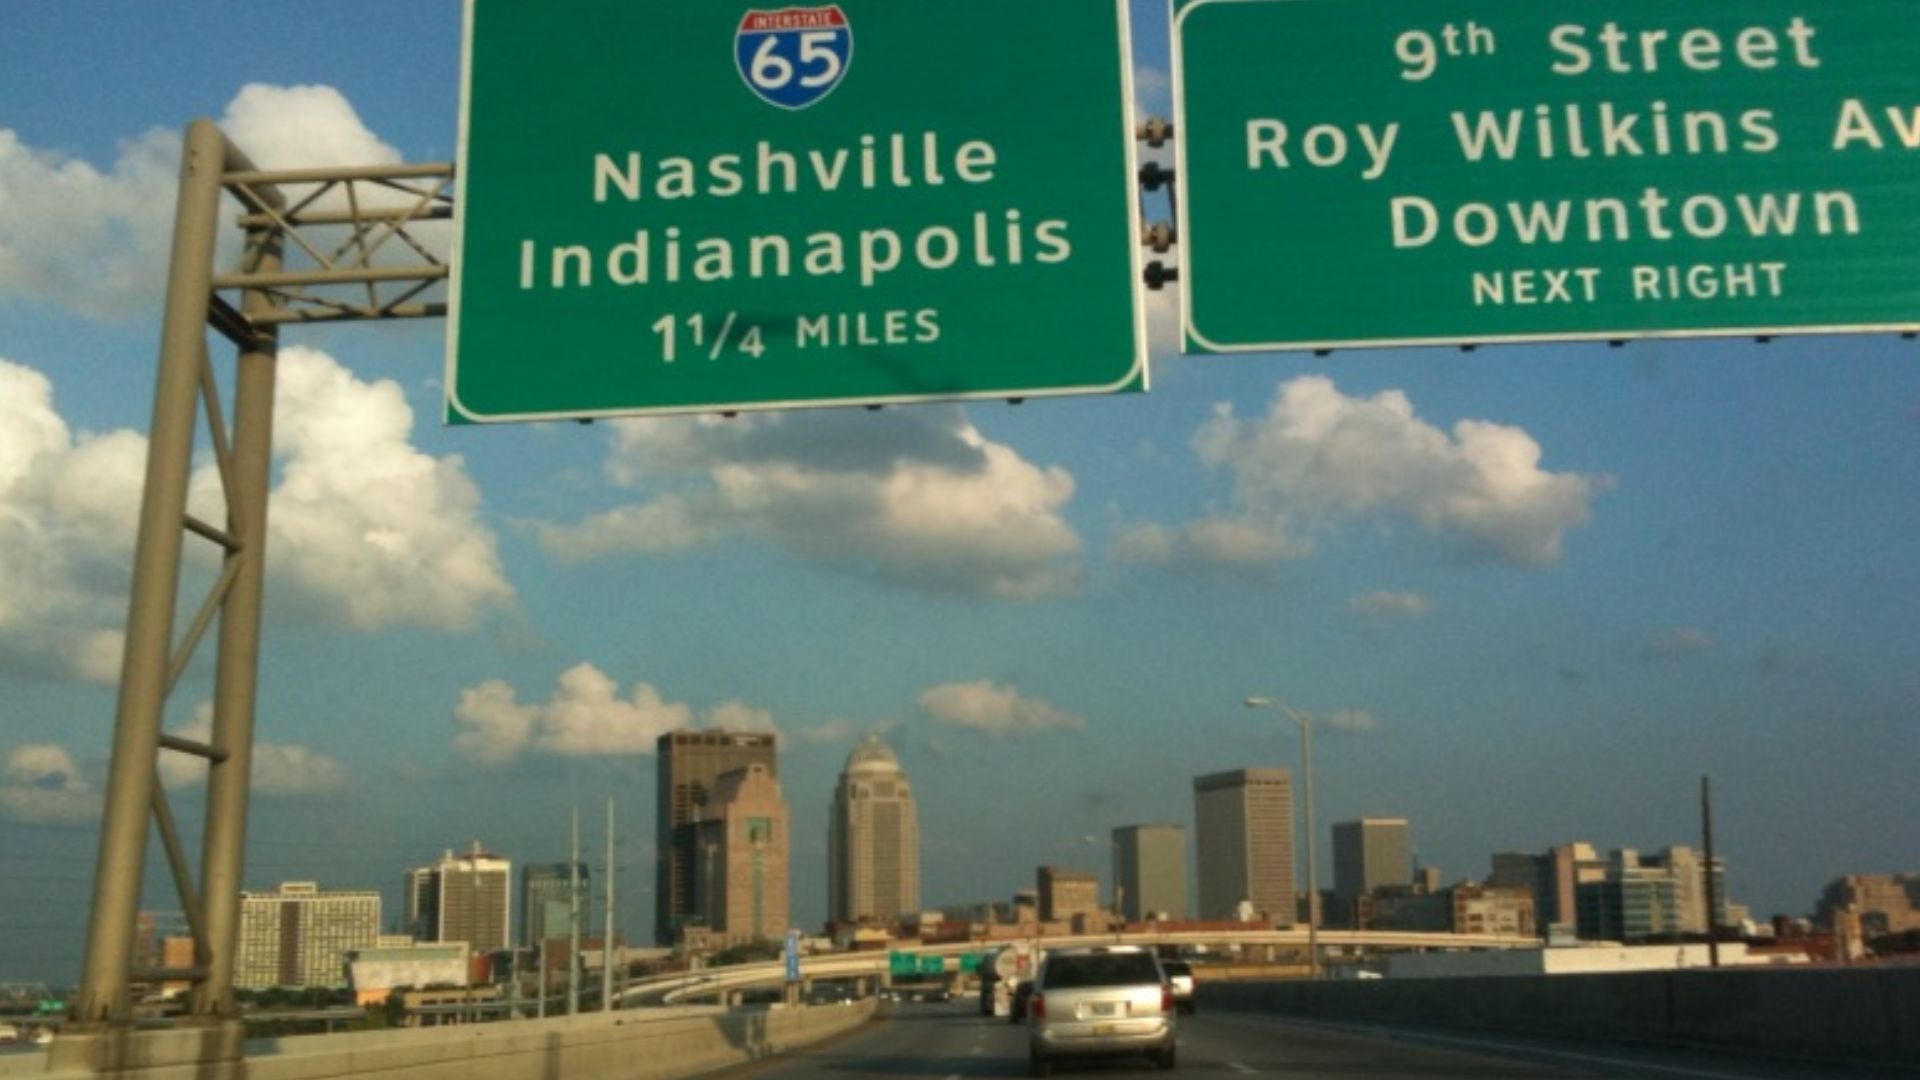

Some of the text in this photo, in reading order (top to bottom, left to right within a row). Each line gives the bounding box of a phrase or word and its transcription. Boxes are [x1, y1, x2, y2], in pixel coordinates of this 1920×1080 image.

[753, 12, 831, 29] INTERSTATE
[1395, 17, 1819, 80] 9th Street
[751, 32, 841, 89] 65
[595, 132, 996, 202] Nashville
[1247, 119, 1398, 180] Roy
[1451, 101, 1778, 161] Wilkins
[1391, 187, 1859, 247] Downtown
[521, 209, 1070, 288] Indianapolis
[1473, 262, 1785, 305] NEXT RIGHT
[798, 309, 939, 346] MILES
